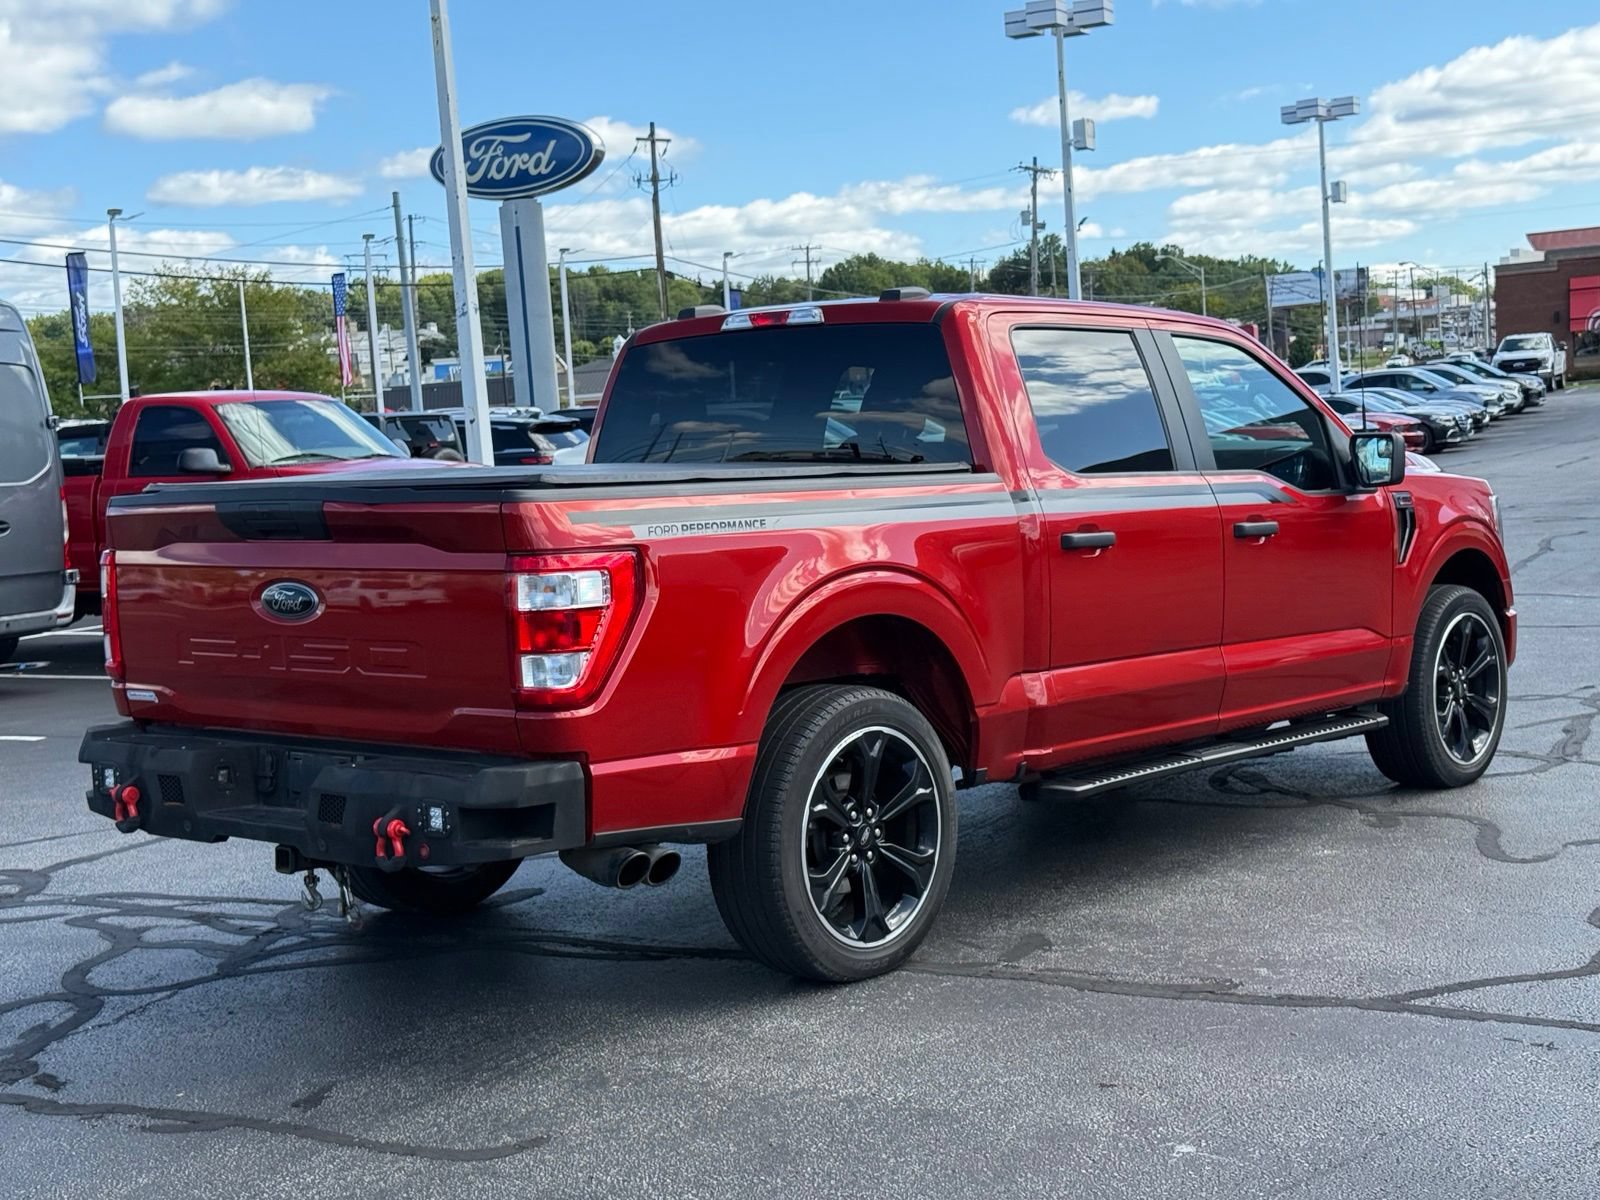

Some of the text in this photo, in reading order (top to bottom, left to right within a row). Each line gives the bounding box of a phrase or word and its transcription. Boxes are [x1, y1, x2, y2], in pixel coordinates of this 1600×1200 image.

[465, 132, 556, 184] Ford
[647, 518, 767, 537] FORD PERFORMANCE
[271, 589, 304, 610] Ford
[177, 633, 428, 680] F-150
